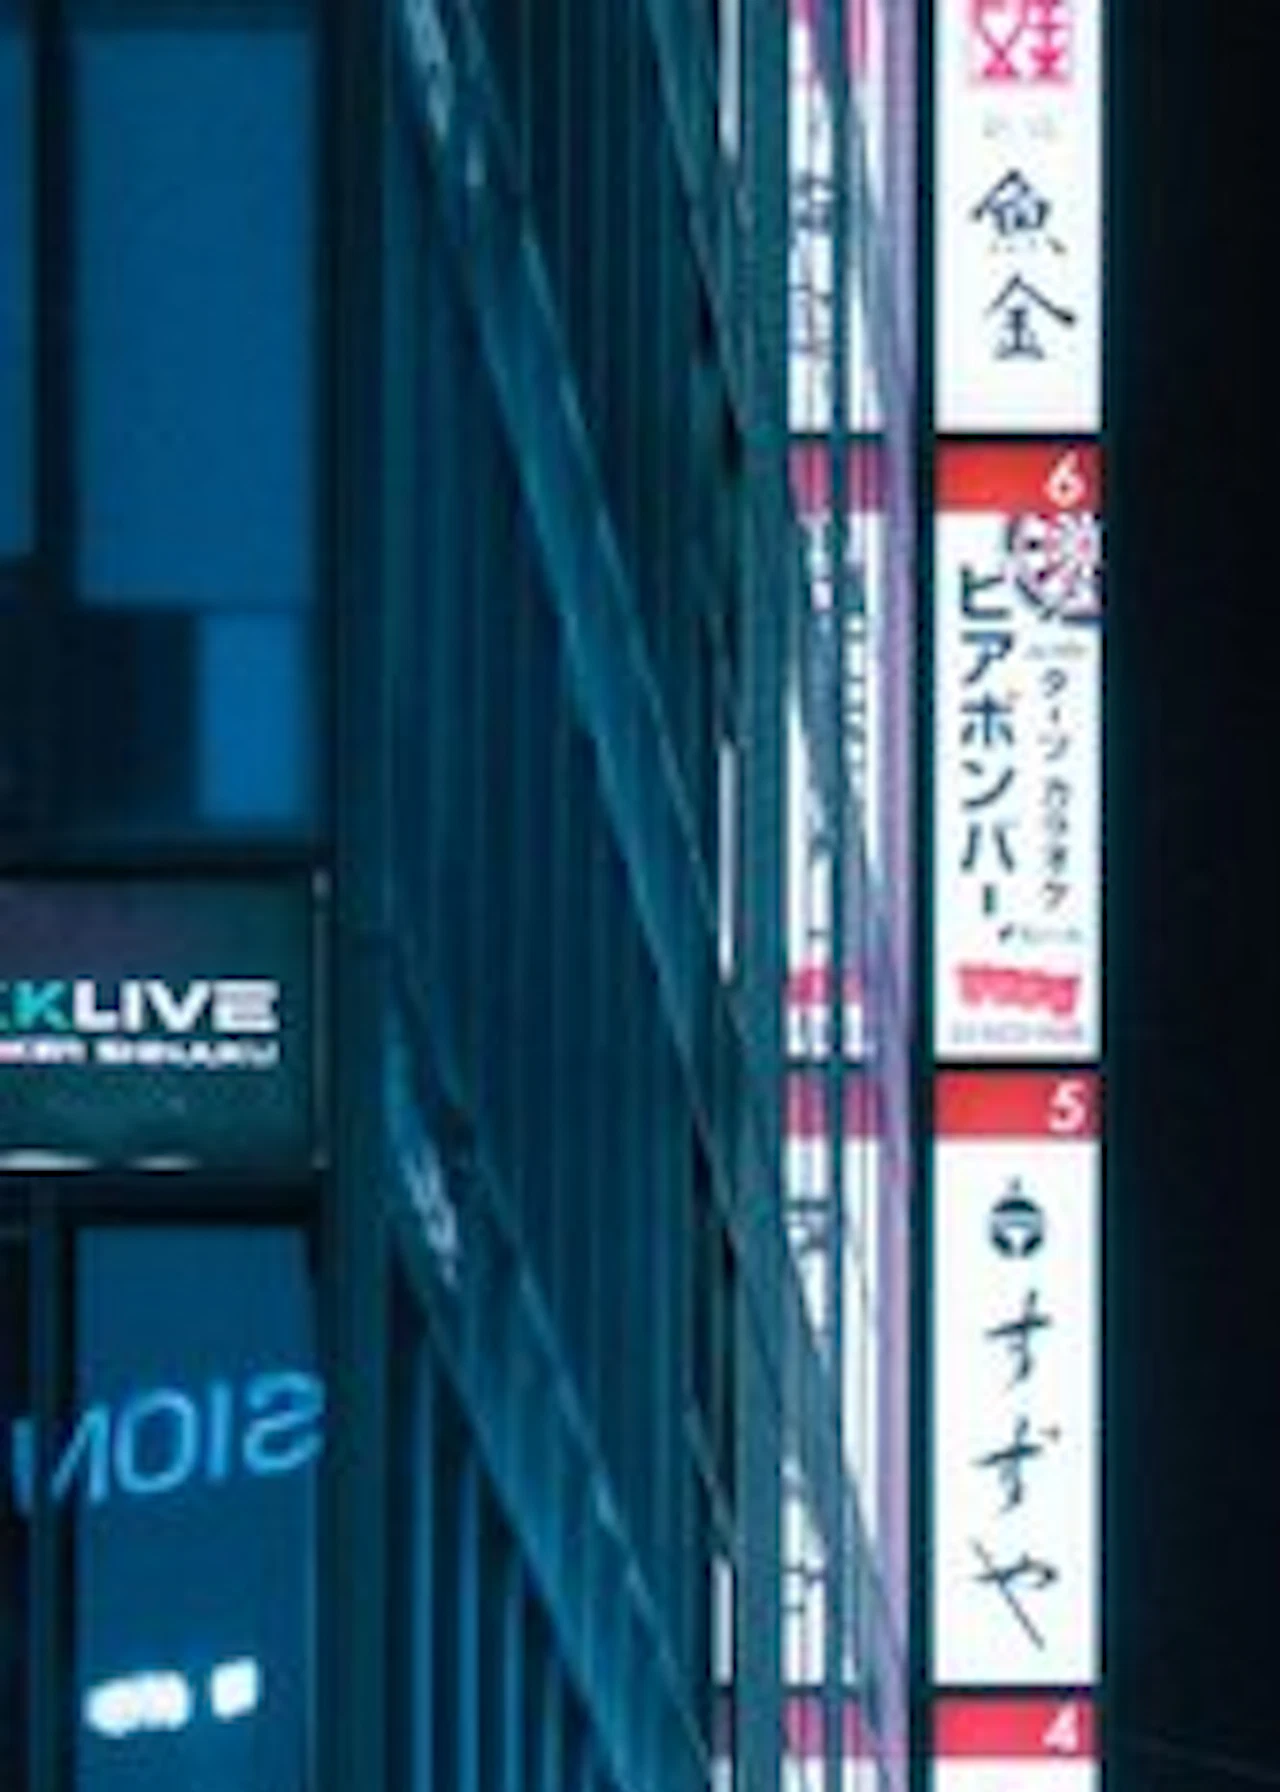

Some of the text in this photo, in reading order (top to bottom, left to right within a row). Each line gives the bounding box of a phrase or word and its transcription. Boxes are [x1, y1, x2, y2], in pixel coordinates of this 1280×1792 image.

[970, 168, 1078, 361] 魚金
[1044, 454, 1085, 507] 6
[0, 979, 279, 1032] KLIVE
[1047, 1081, 1086, 1133] 5
[1042, 1705, 1080, 1752] 4
